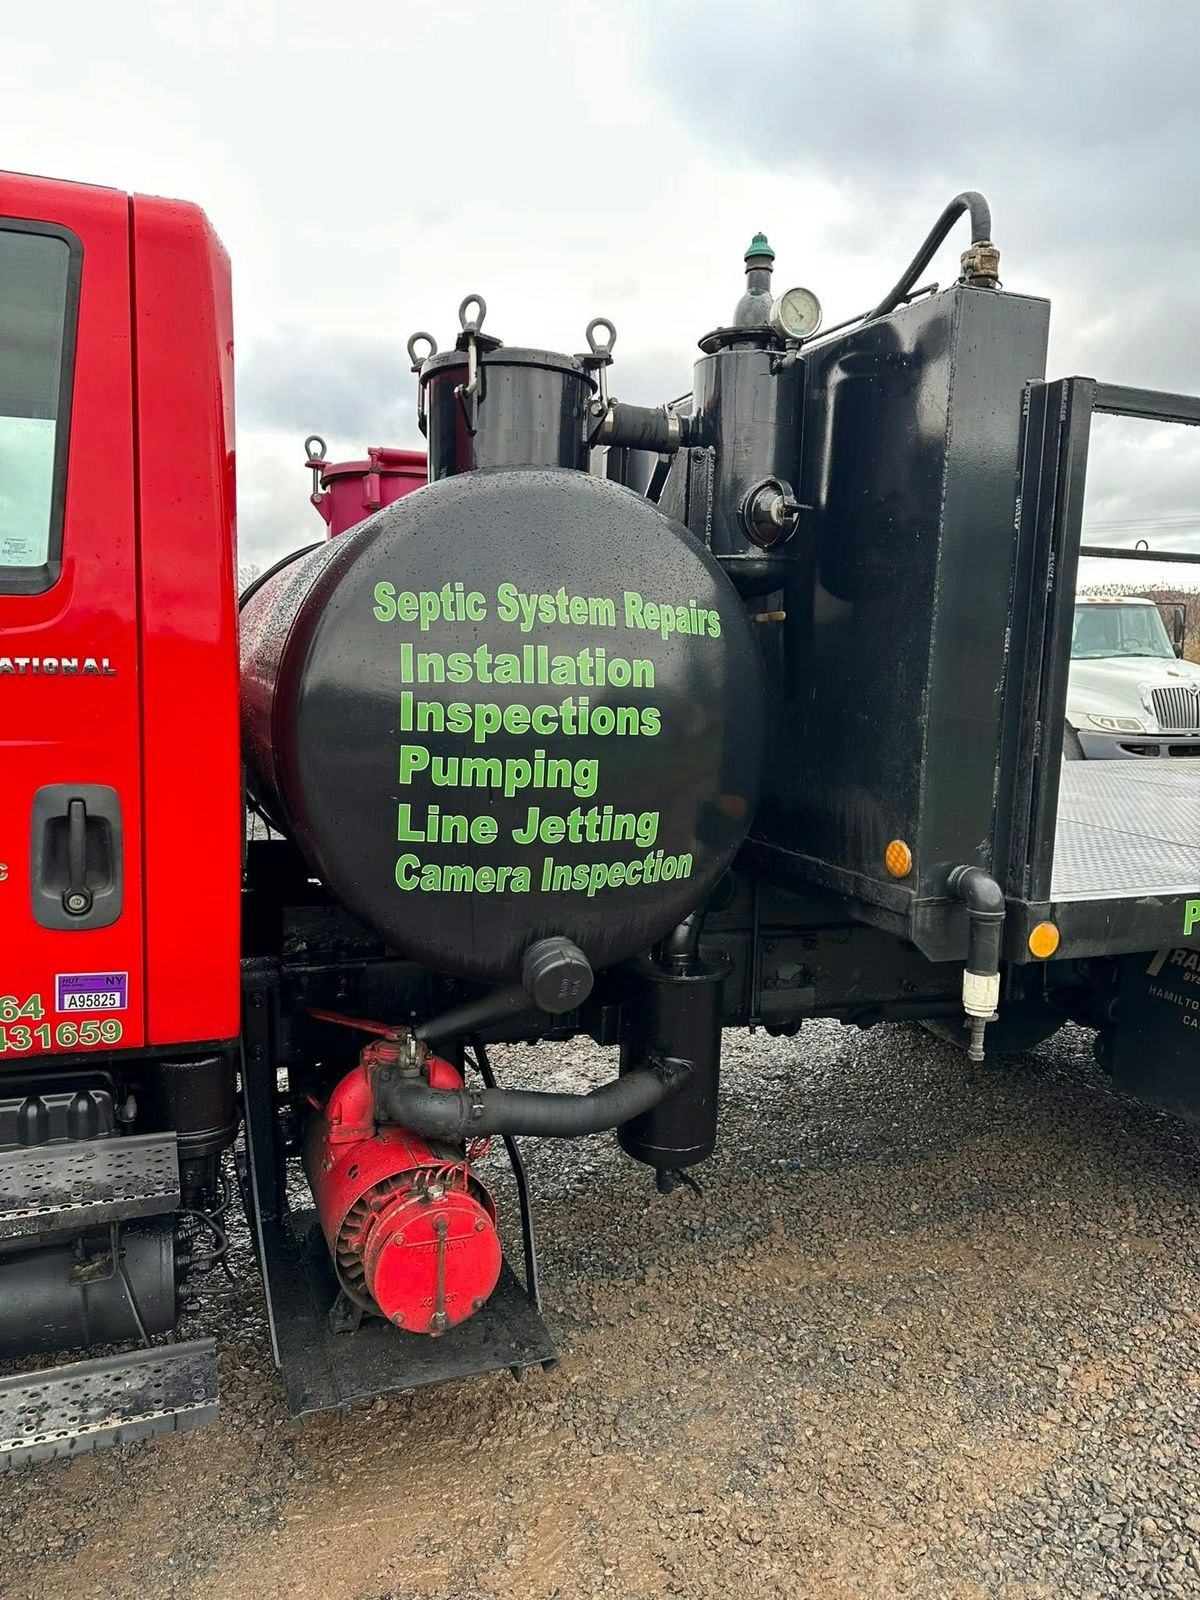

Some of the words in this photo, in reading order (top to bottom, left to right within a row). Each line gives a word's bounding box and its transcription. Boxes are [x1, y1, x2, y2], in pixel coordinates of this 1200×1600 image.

[373, 581, 487, 630] Septic
[497, 582, 616, 632] System
[624, 591, 721, 640] Repairs
[0, 658, 116, 675] ATIONAL
[400, 643, 655, 688] Installation
[400, 691, 662, 743] Inspections
[399, 745, 599, 798] Pumping
[397, 804, 498, 844] Line
[512, 805, 660, 847] Jetting
[395, 854, 531, 892] Camera
[541, 850, 693, 897] Inspection
[105, 976, 124, 985] NY
[1148, 984, 1200, 1010] HAMILTO
[0, 993, 45, 1023] 64
[68, 993, 116, 1008] A95825
[1182, 1015, 1200, 1029] CA
